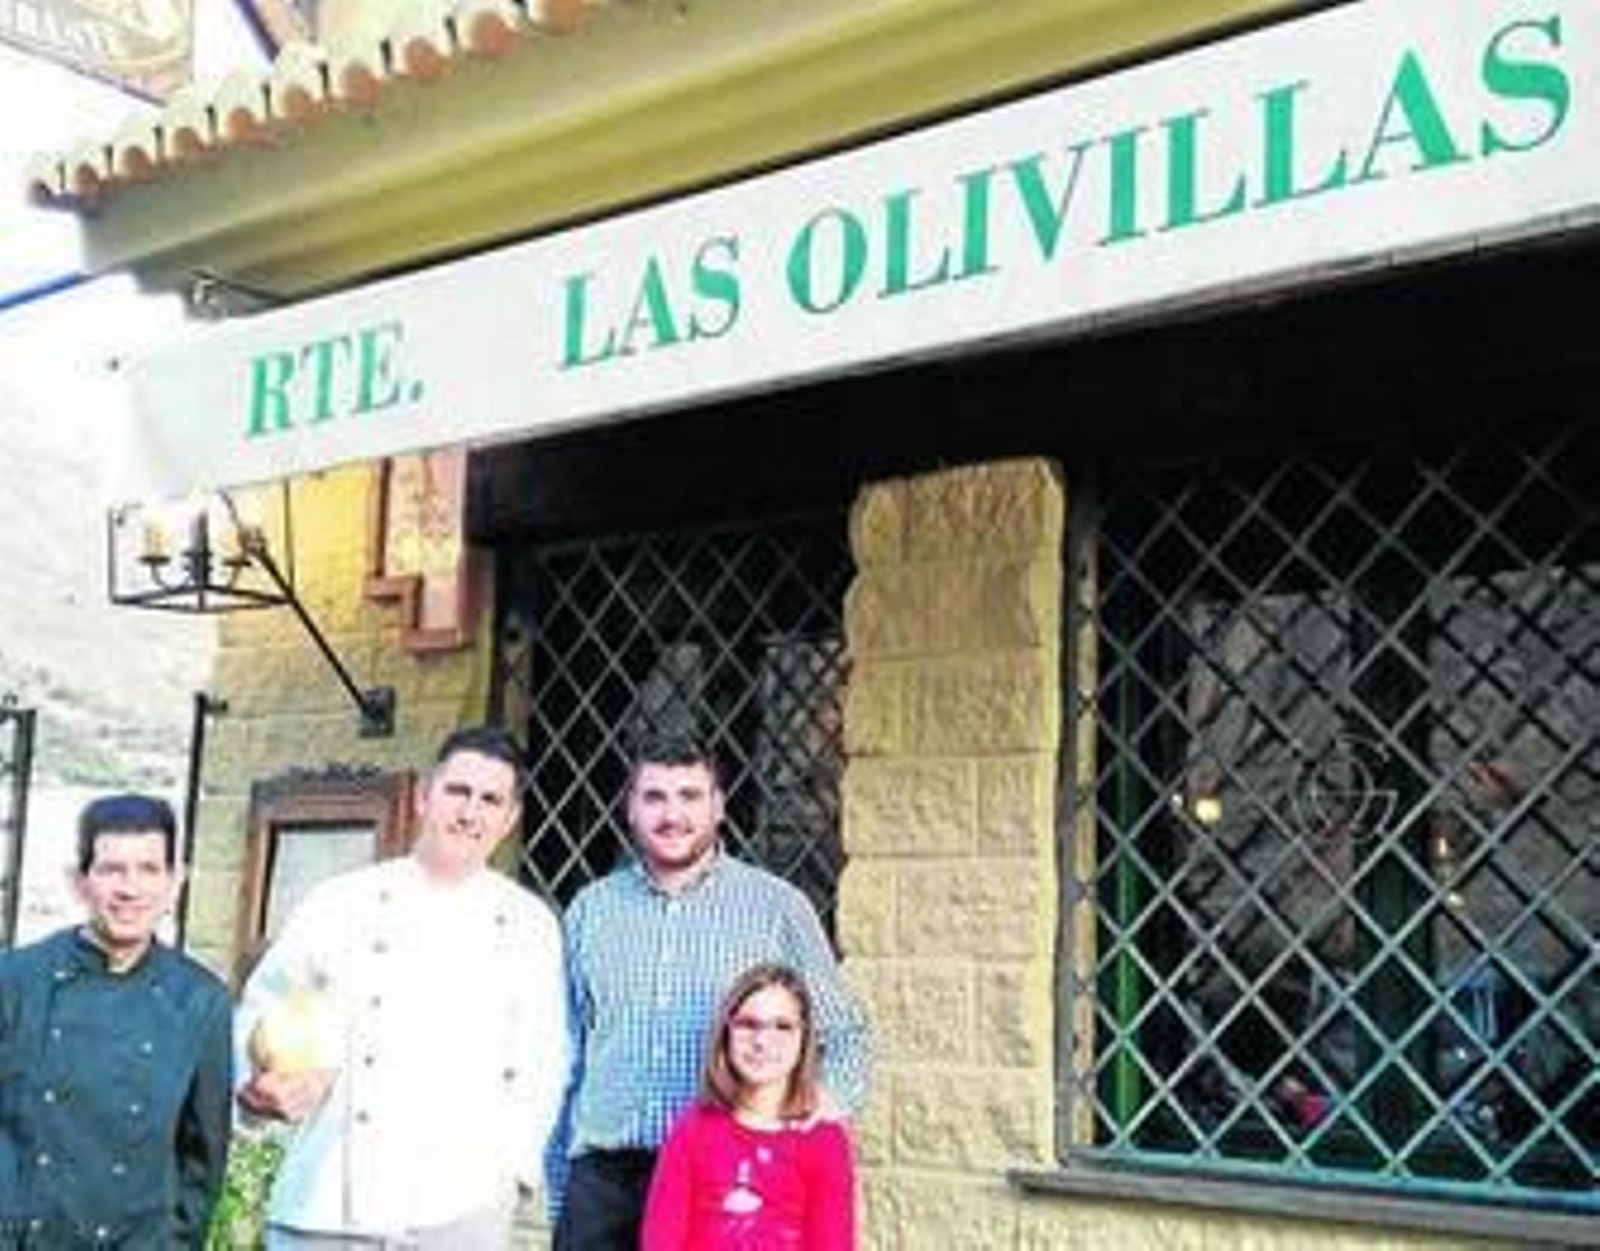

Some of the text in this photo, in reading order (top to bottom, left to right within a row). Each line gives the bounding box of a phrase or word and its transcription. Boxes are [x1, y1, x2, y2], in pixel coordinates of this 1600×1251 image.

[245, 14, 1572, 437] RTE. LAS OLIVILLAS
